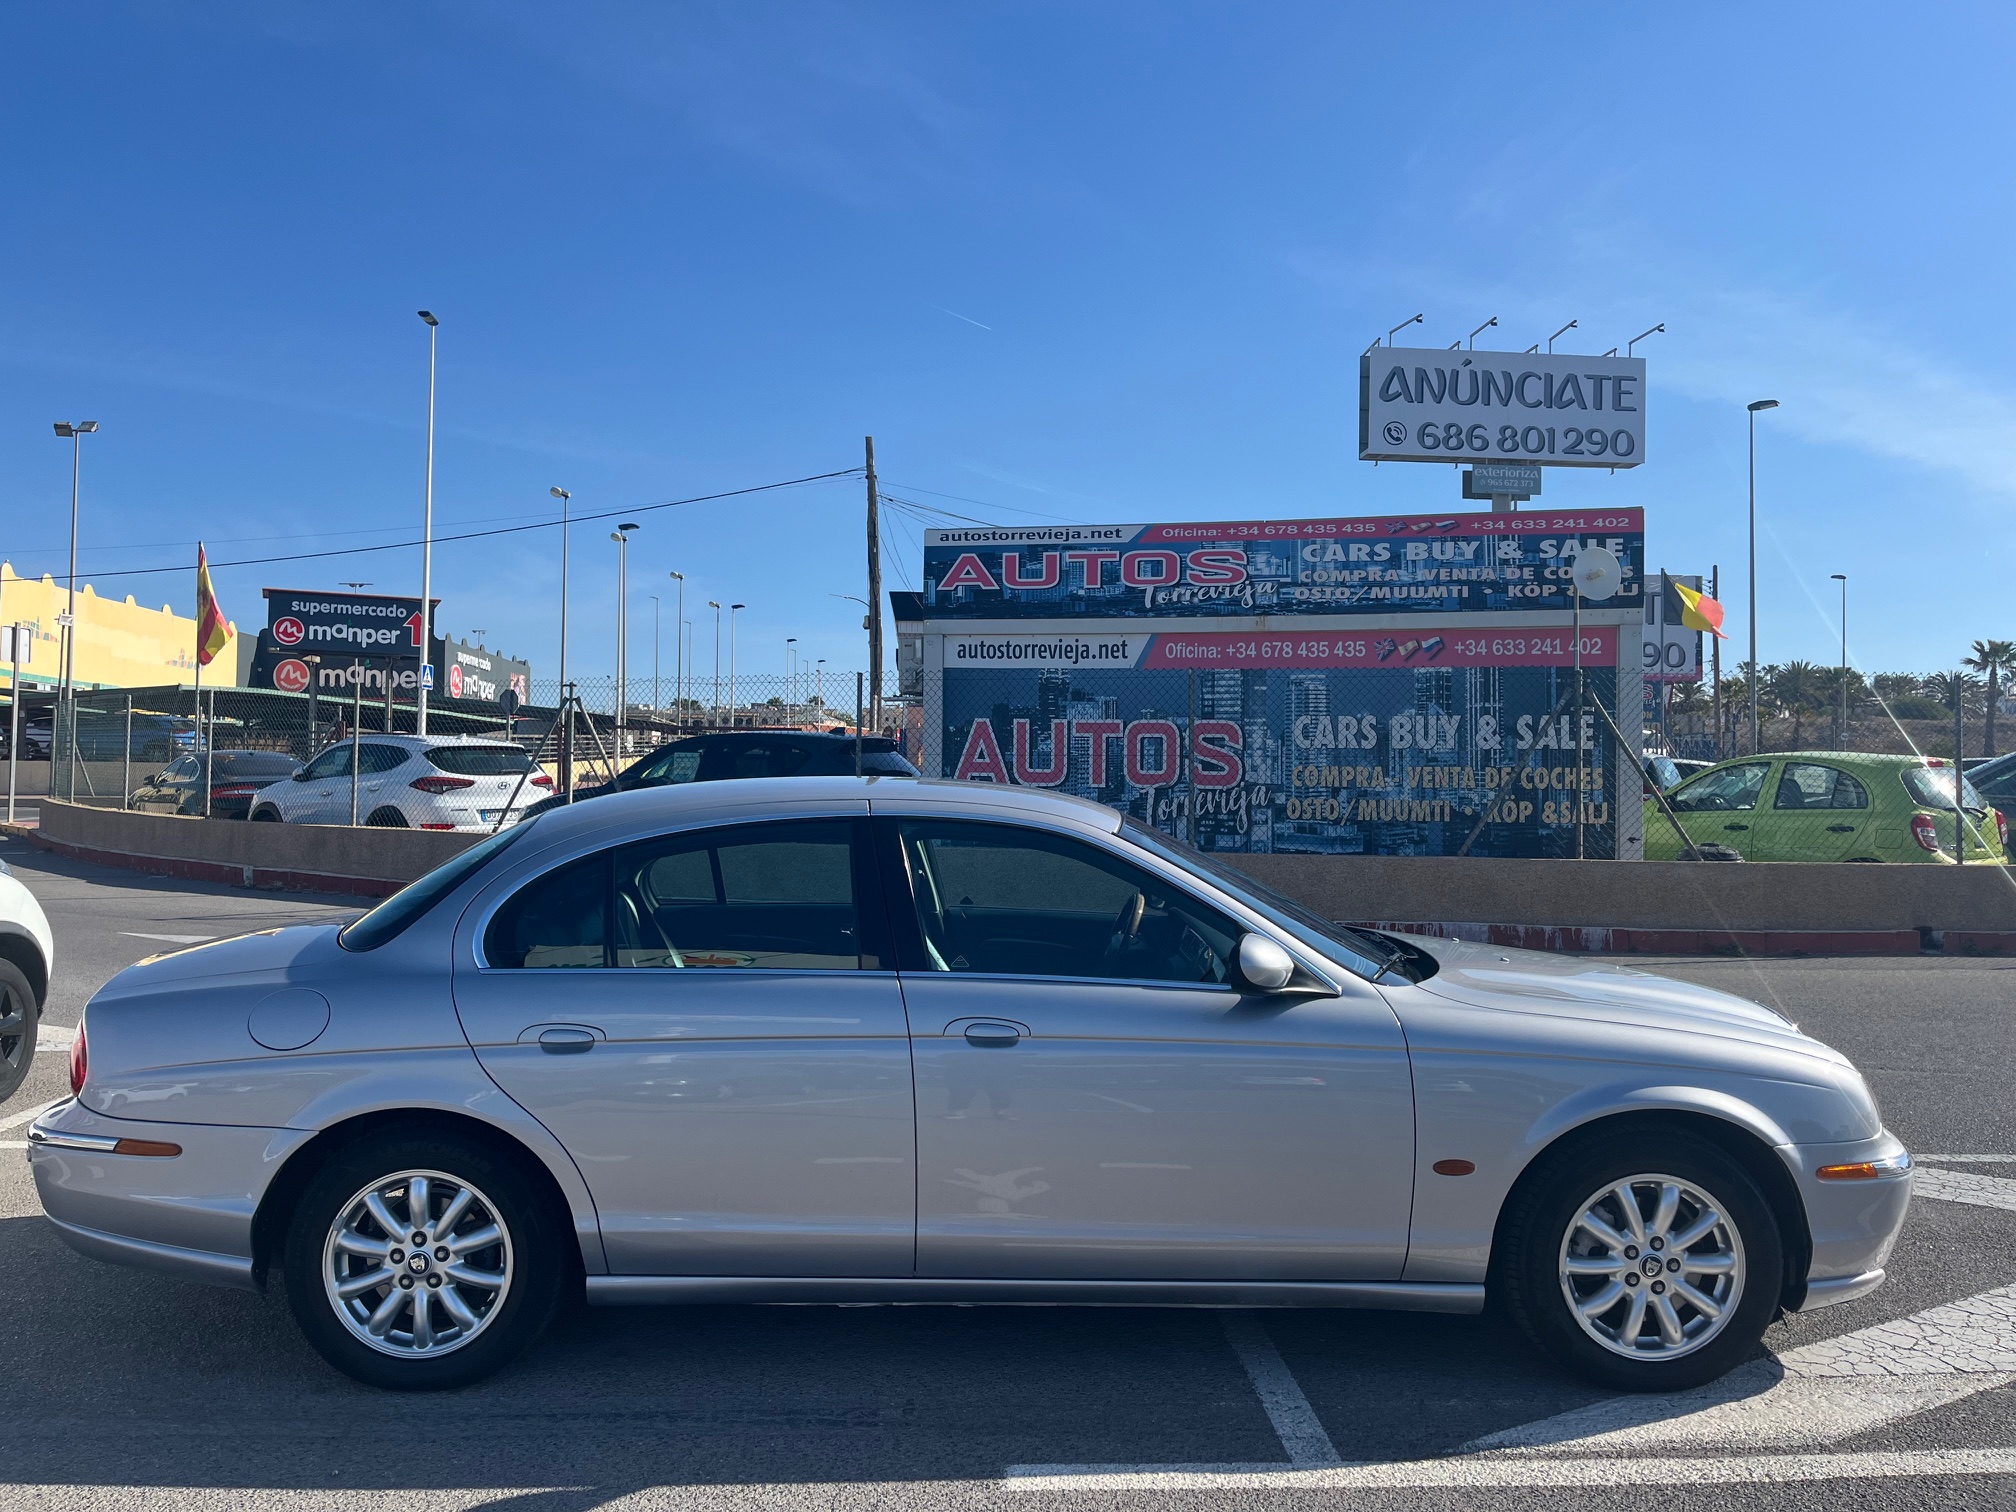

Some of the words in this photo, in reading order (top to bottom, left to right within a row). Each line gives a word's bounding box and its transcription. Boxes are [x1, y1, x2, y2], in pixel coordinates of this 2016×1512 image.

[1379, 358, 1637, 412] ANÚNCIATE
[1417, 422, 1489, 452] 686
[1496, 425, 1555, 454] 801
[1562, 427, 1635, 457] 290
[1487, 478, 1503, 486] 965
[1504, 479, 1519, 487] 672
[1520, 480, 1534, 488] 373
[939, 528, 1123, 544] autostorrevieja.net
[1162, 528, 1222, 537] Oficina:
[1227, 527, 1259, 536] +34
[1264, 526, 1297, 535] 678
[1303, 524, 1337, 534] 435
[1342, 523, 1376, 533] 435
[1471, 520, 1506, 530] +34
[1511, 519, 1547, 529] 633
[1552, 518, 1588, 528] 241
[1593, 517, 1630, 527] 402
[1302, 543, 1391, 562] CARS
[1406, 540, 1480, 560] BUY
[1496, 541, 1524, 559] &
[936, 550, 1249, 591] AUTOS
[1300, 569, 1399, 583] COMPRA
[1423, 567, 1497, 581] VENTA
[1506, 567, 1534, 579] DE
[1543, 566, 1634, 579] COS
[1143, 580, 1279, 609] Torrevieja
[1508, 582, 1557, 598] KÖP
[291, 600, 407, 618] supermercado
[308, 624, 401, 648] manper
[1165, 642, 1222, 659] Oficina:
[1226, 642, 1257, 658] +34
[1261, 642, 1293, 657] 678
[1297, 642, 1329, 657] 435
[1333, 641, 1366, 657] 435
[1454, 639, 1488, 655] +34
[1492, 639, 1526, 655] 633
[1531, 638, 1563, 654] 241
[956, 639, 1129, 664] autostorrevieja.net
[319, 665, 422, 695] manpe
[463, 674, 496, 701] manper
[1294, 714, 1378, 750] CARS
[1391, 715, 1462, 750] BUY
[1475, 714, 1502, 750] &
[1516, 714, 1595, 750] SALE
[954, 718, 1245, 789] AUTOS
[1291, 764, 1386, 788] COMPRA
[1407, 766, 1477, 789] VENTA
[1520, 767, 1604, 790] COCHES
